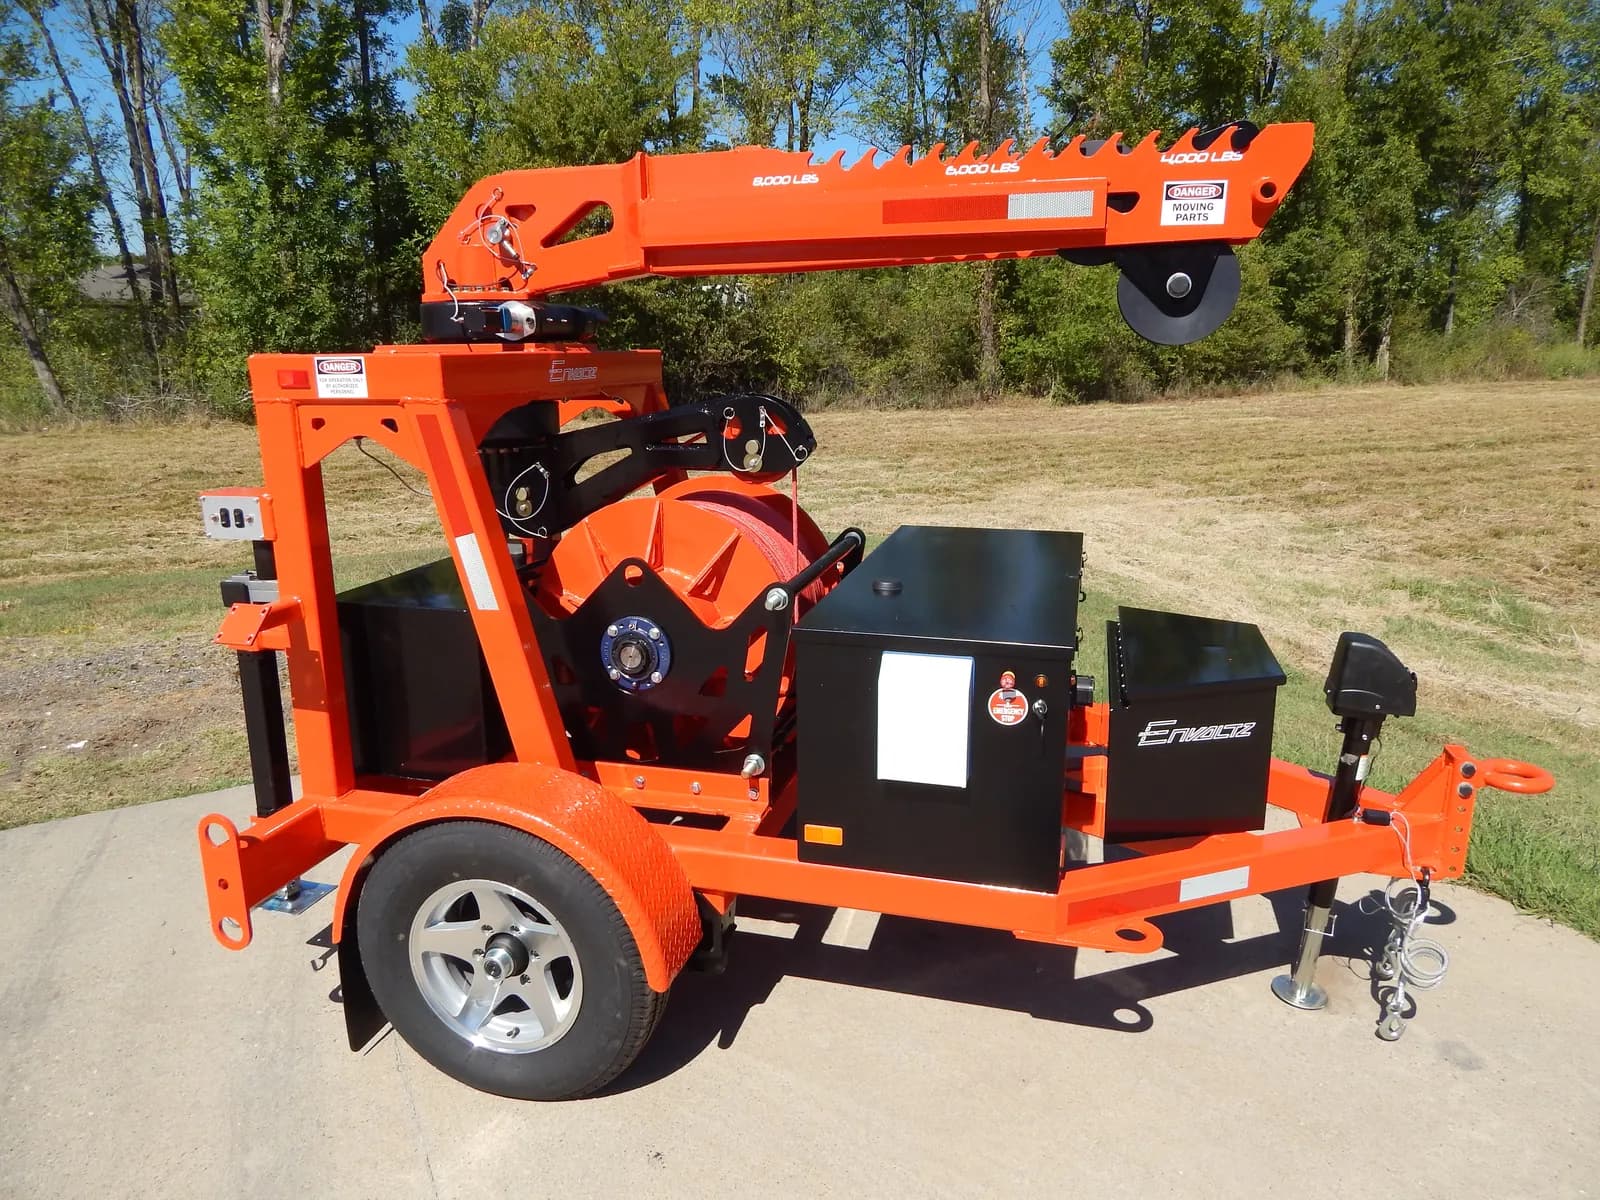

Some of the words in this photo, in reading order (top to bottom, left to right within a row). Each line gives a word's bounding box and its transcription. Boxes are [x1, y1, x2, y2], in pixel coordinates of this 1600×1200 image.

[1160, 152, 1209, 165] 4,000
[1210, 150, 1244, 162] LBS
[945, 163, 989, 176] 6,000
[990, 161, 1020, 174] LBS
[752, 175, 791, 187] 8,000
[792, 173, 819, 185] LBS
[1173, 186, 1217, 197] DANGER
[1172, 202, 1214, 212] MOVING
[1175, 212, 1209, 222] PARTS
[323, 362, 357, 372] DANGER
[992, 707, 1025, 716] EMERGENCY
